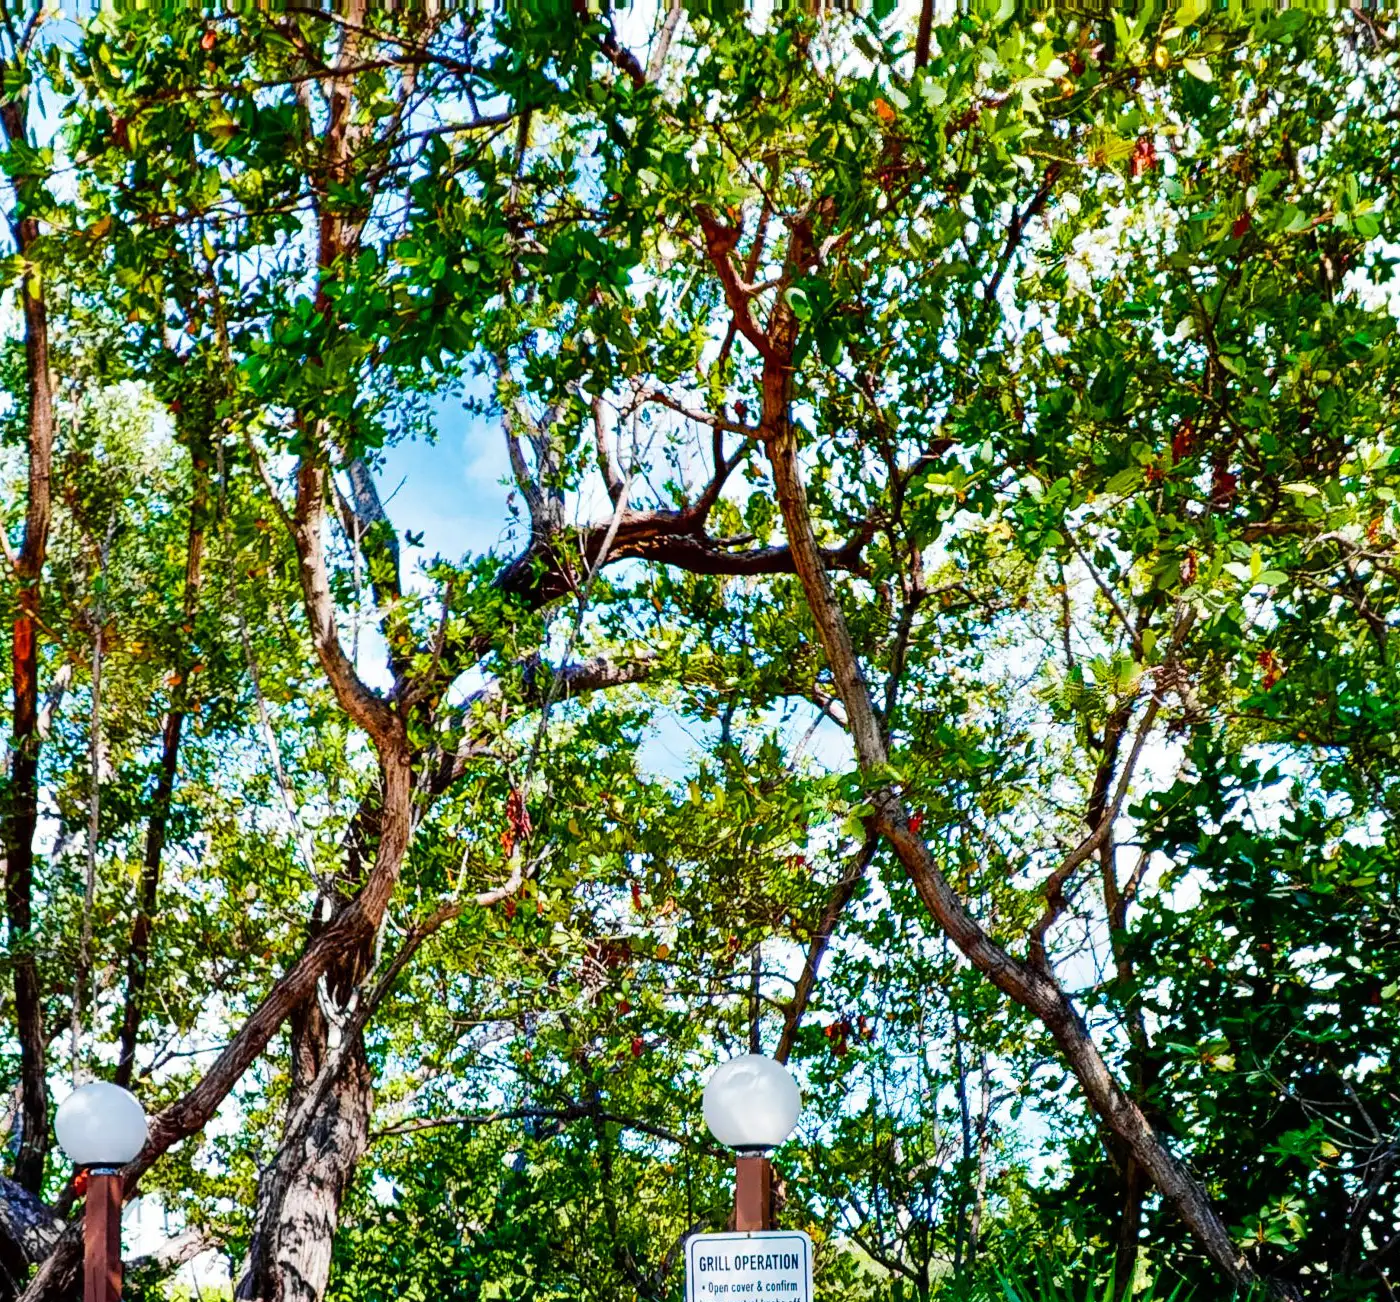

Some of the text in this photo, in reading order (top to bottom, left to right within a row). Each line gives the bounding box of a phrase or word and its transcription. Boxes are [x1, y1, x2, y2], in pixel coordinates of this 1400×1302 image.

[699, 1253, 799, 1271] GRILL OPERATION
[708, 1279, 798, 1296] Open cover & confirm
